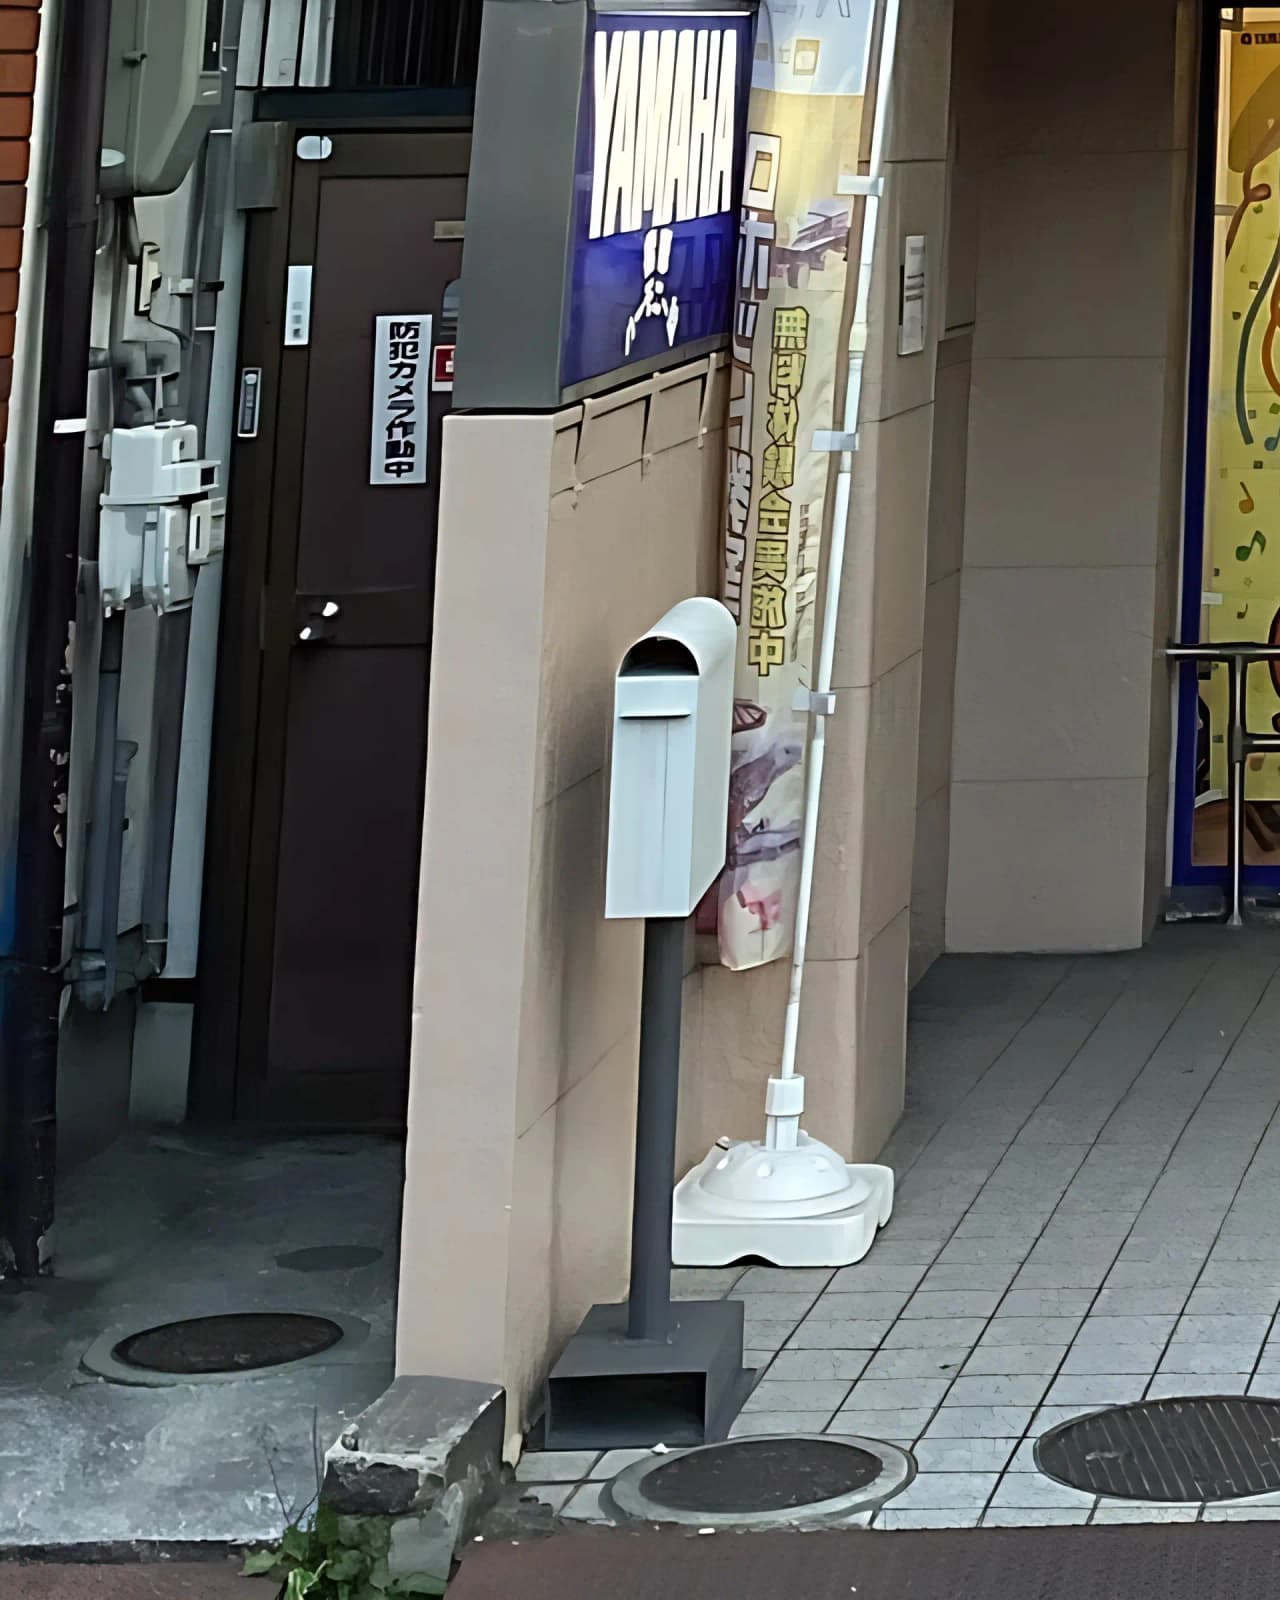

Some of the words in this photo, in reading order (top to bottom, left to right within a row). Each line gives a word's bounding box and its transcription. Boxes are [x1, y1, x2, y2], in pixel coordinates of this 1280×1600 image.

[588, 27, 739, 241] YAMAHA
[383, 321, 422, 479] 防犯カメラ作動中
